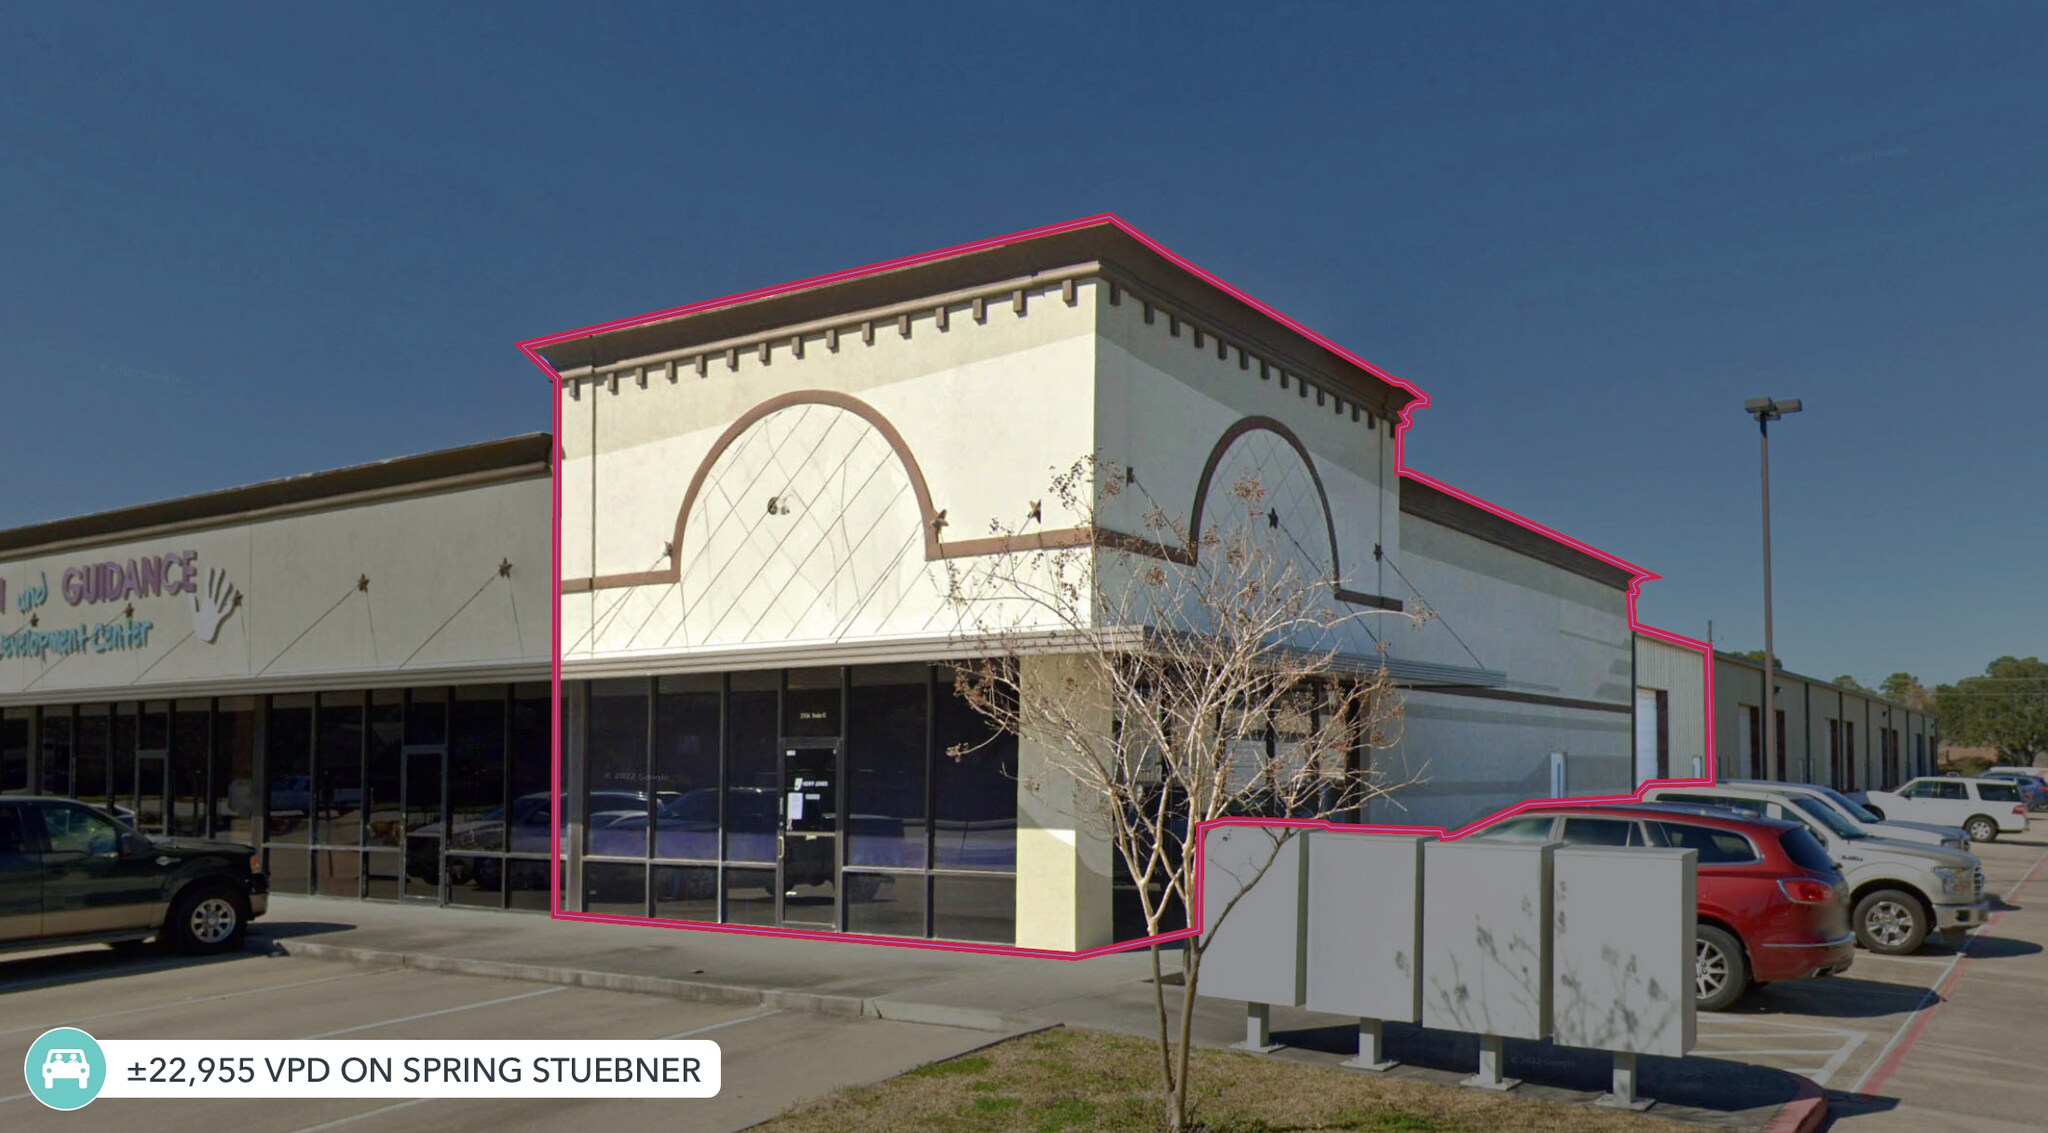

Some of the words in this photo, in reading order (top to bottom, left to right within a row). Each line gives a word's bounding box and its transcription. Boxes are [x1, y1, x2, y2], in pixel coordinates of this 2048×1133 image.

[17, 570, 48, 615] and
[62, 550, 198, 607] GUIDANCE
[0, 623, 87, 664] evelopment
[91, 619, 154, 654] Center
